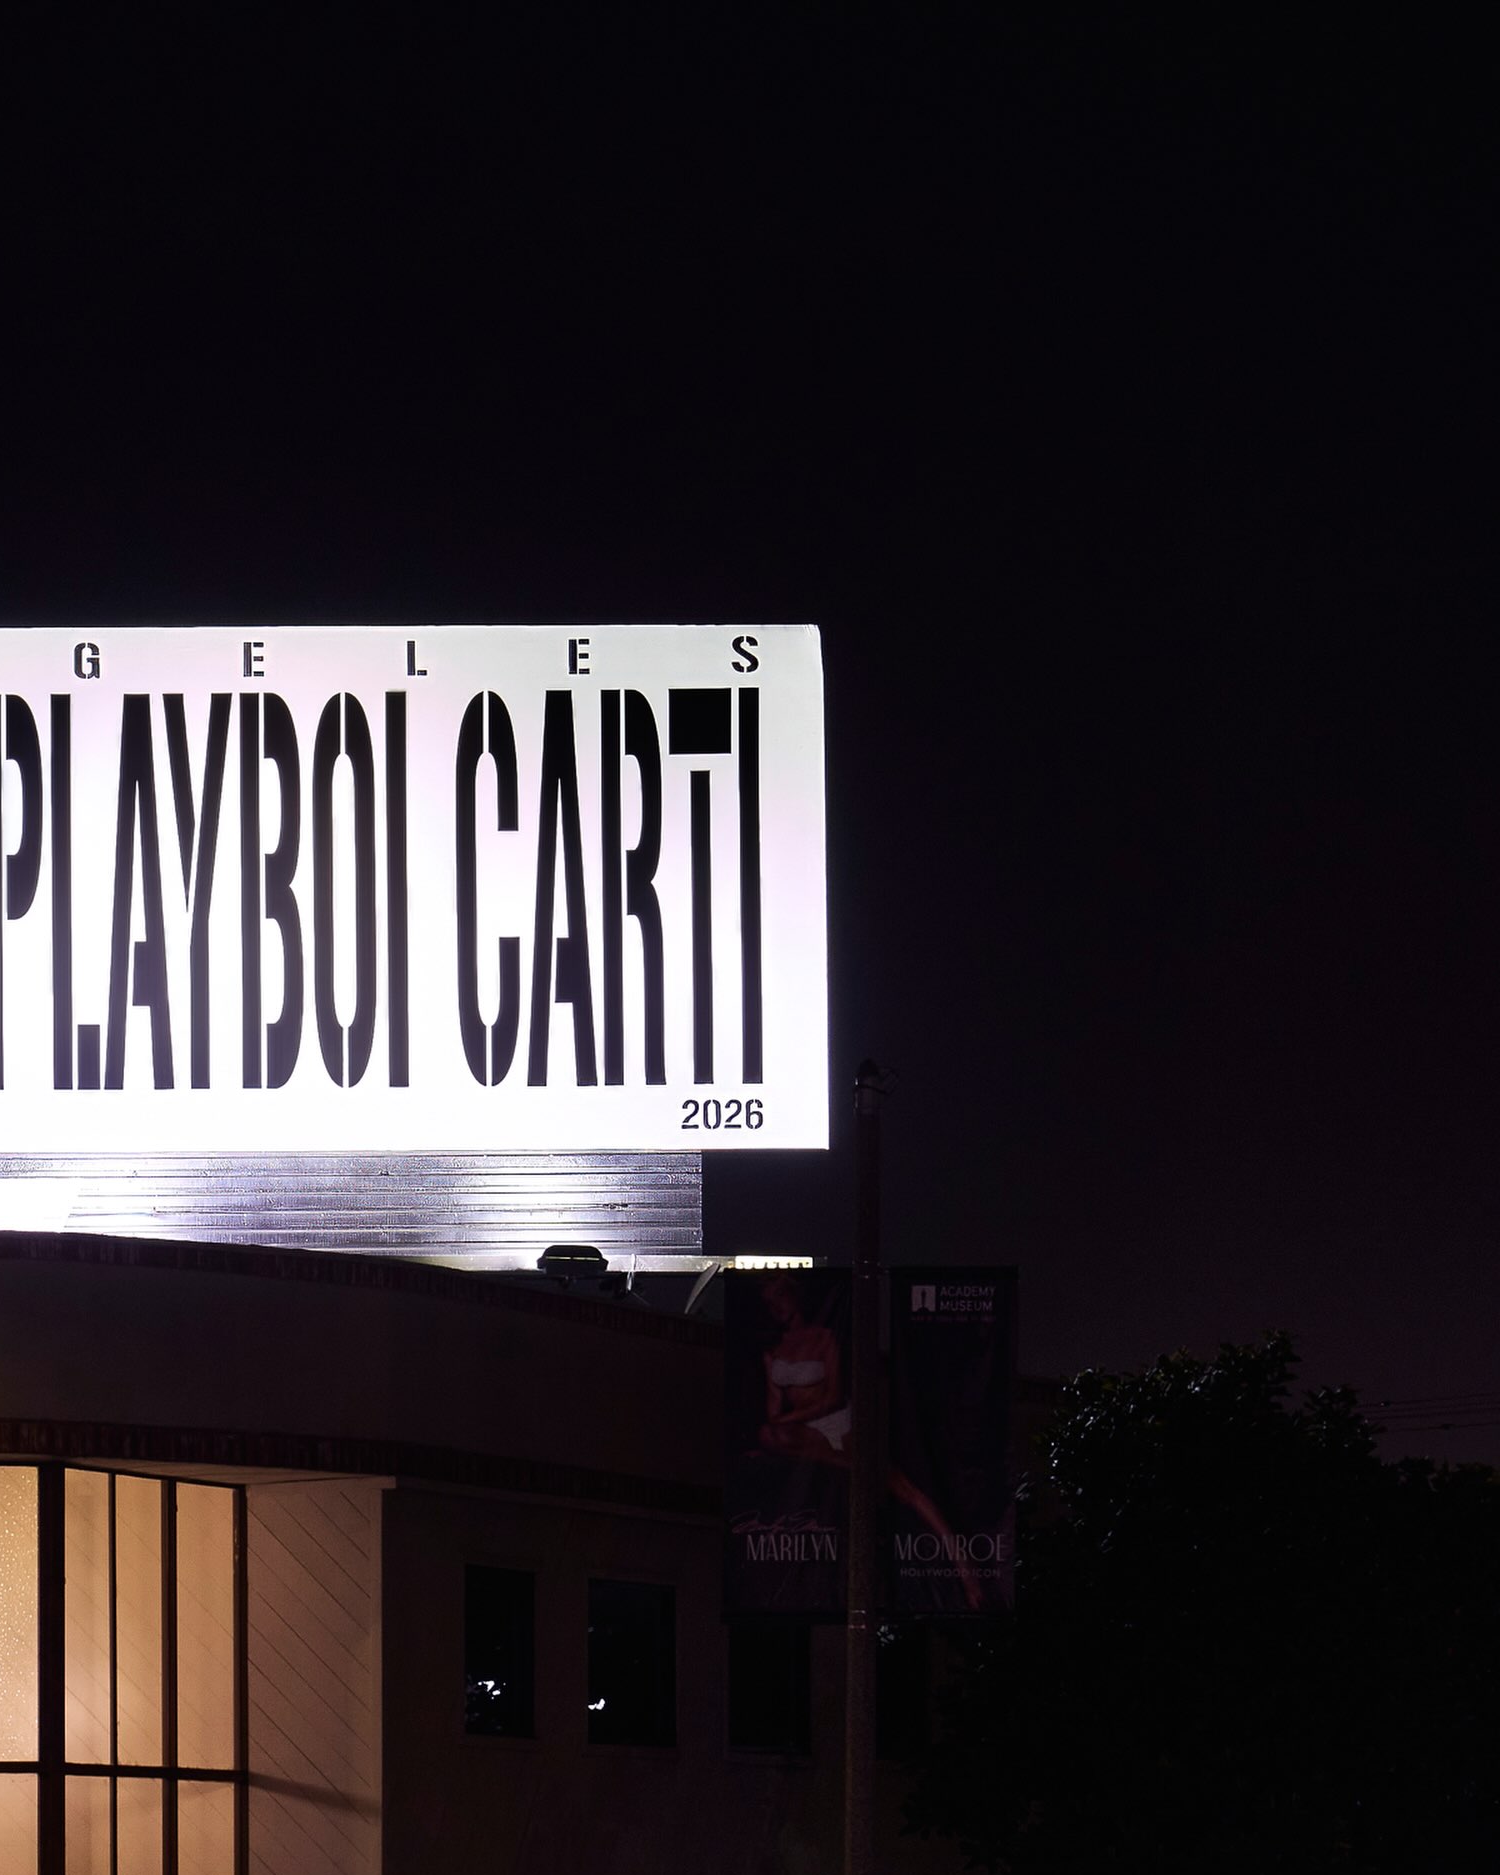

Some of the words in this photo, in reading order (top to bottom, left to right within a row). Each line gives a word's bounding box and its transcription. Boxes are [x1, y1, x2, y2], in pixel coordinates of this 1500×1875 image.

[456, 687, 763, 1087] CARTI
[681, 1098, 764, 1130] 2026
[939, 1285, 996, 1297] ACADEMY
[939, 1300, 994, 1312] MUSEUM
[747, 1533, 837, 1562] MARILYN
[894, 1533, 1008, 1562] MONROE
[899, 1567, 970, 1577] HOLLYWOOD
